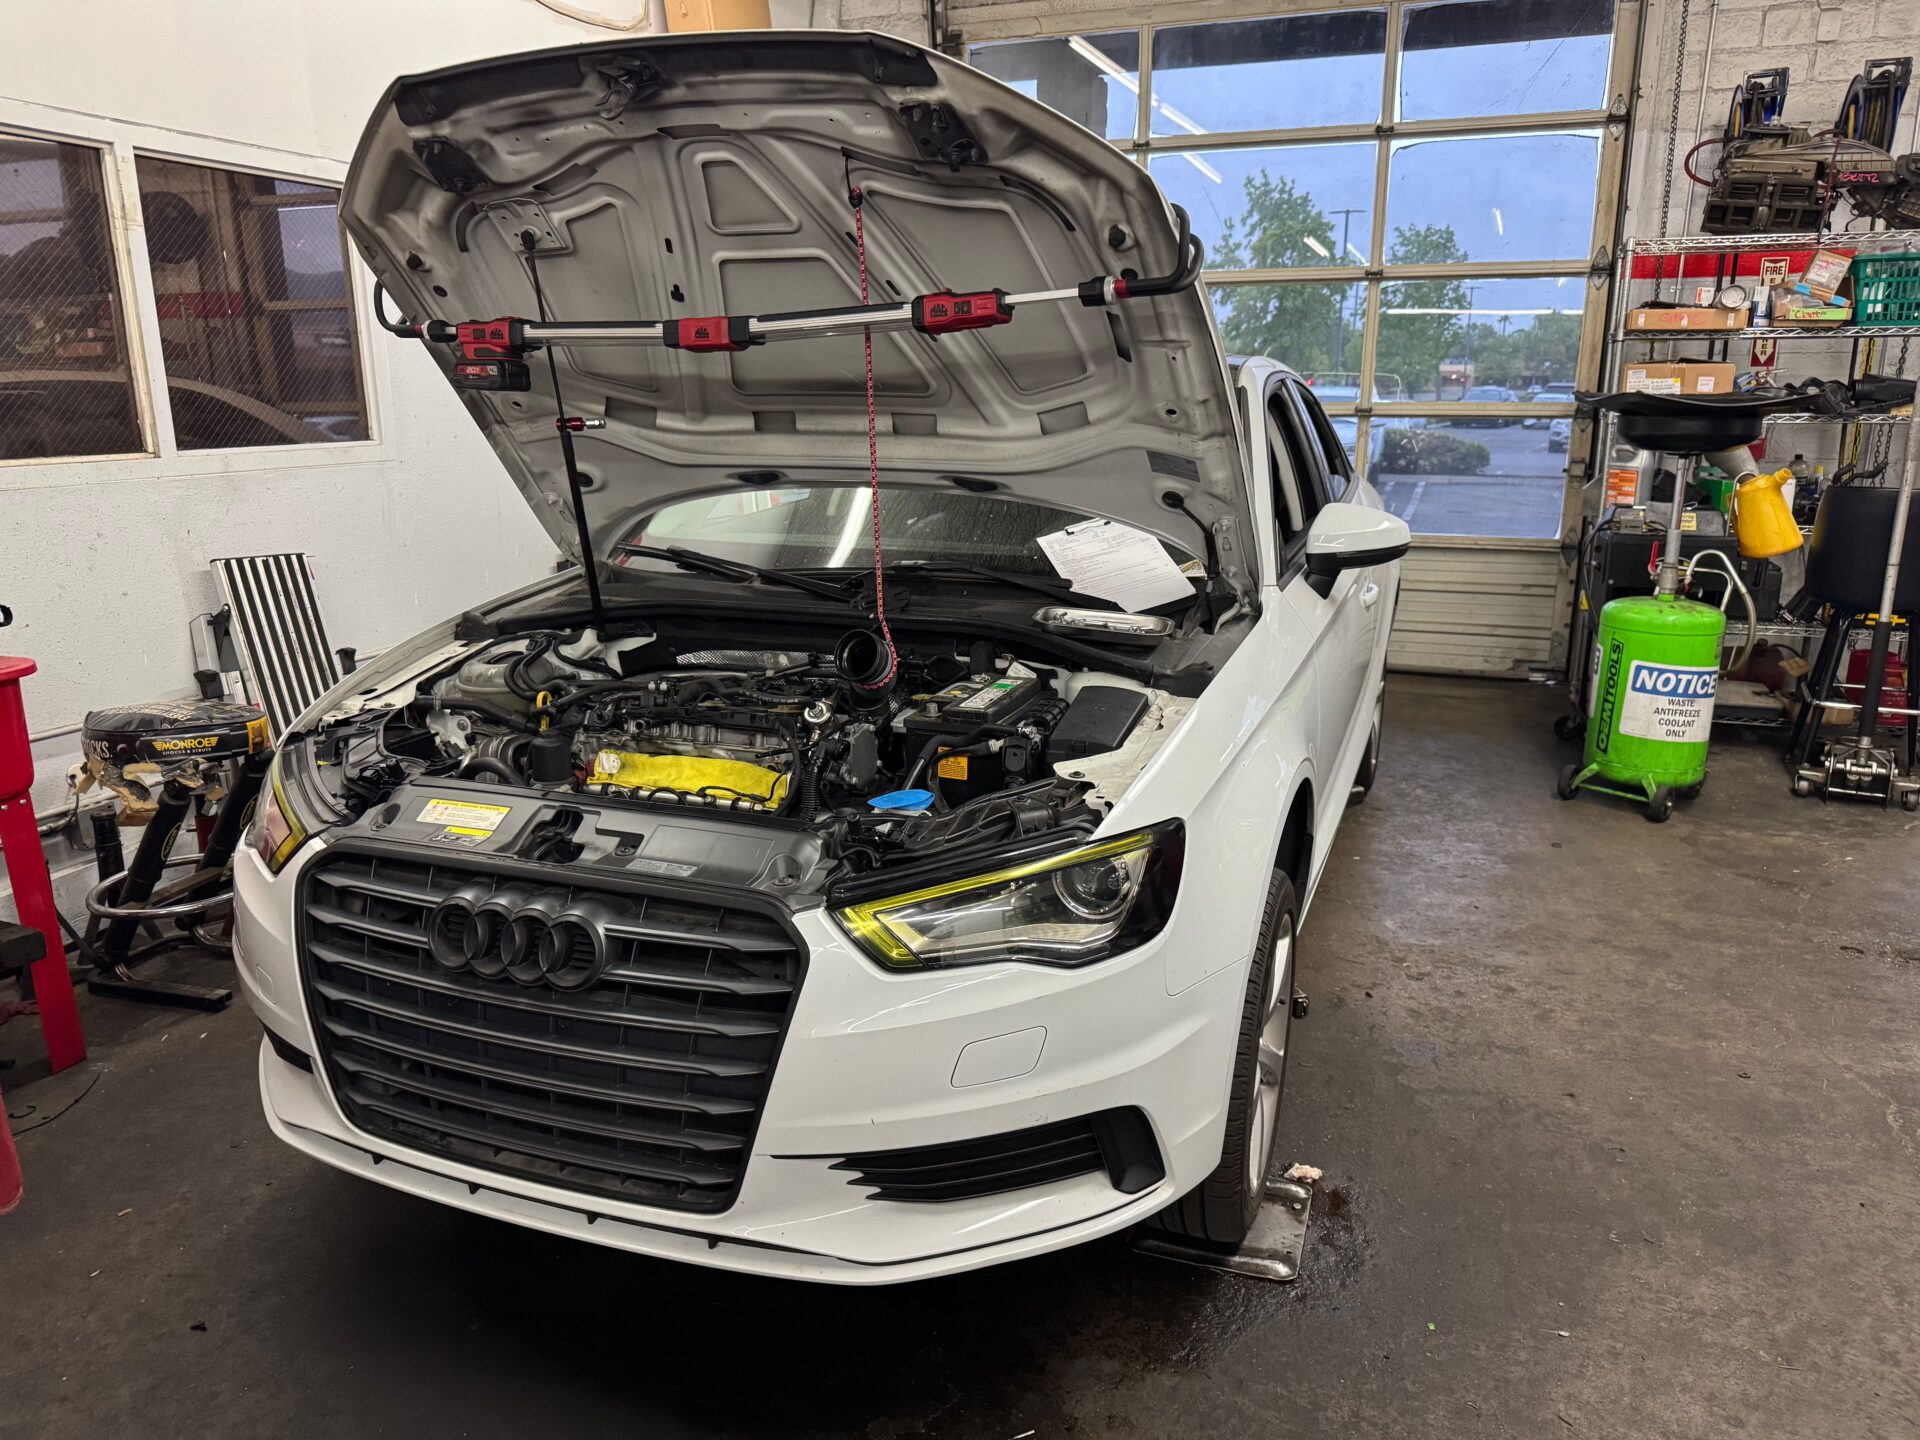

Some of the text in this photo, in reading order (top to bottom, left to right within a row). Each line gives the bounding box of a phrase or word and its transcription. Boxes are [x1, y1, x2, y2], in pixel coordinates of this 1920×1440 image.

[1764, 265, 1784, 276] FIRE
[1635, 669, 1717, 694] NOTICE
[1598, 641, 1621, 751] OEMTOOLS
[1668, 698, 1696, 707] WASTE
[1653, 707, 1702, 718] ANTIFREEZE
[1658, 718, 1696, 728] COOLANT
[1665, 729, 1687, 738] ONLY
[157, 737, 214, 751] MONROE
